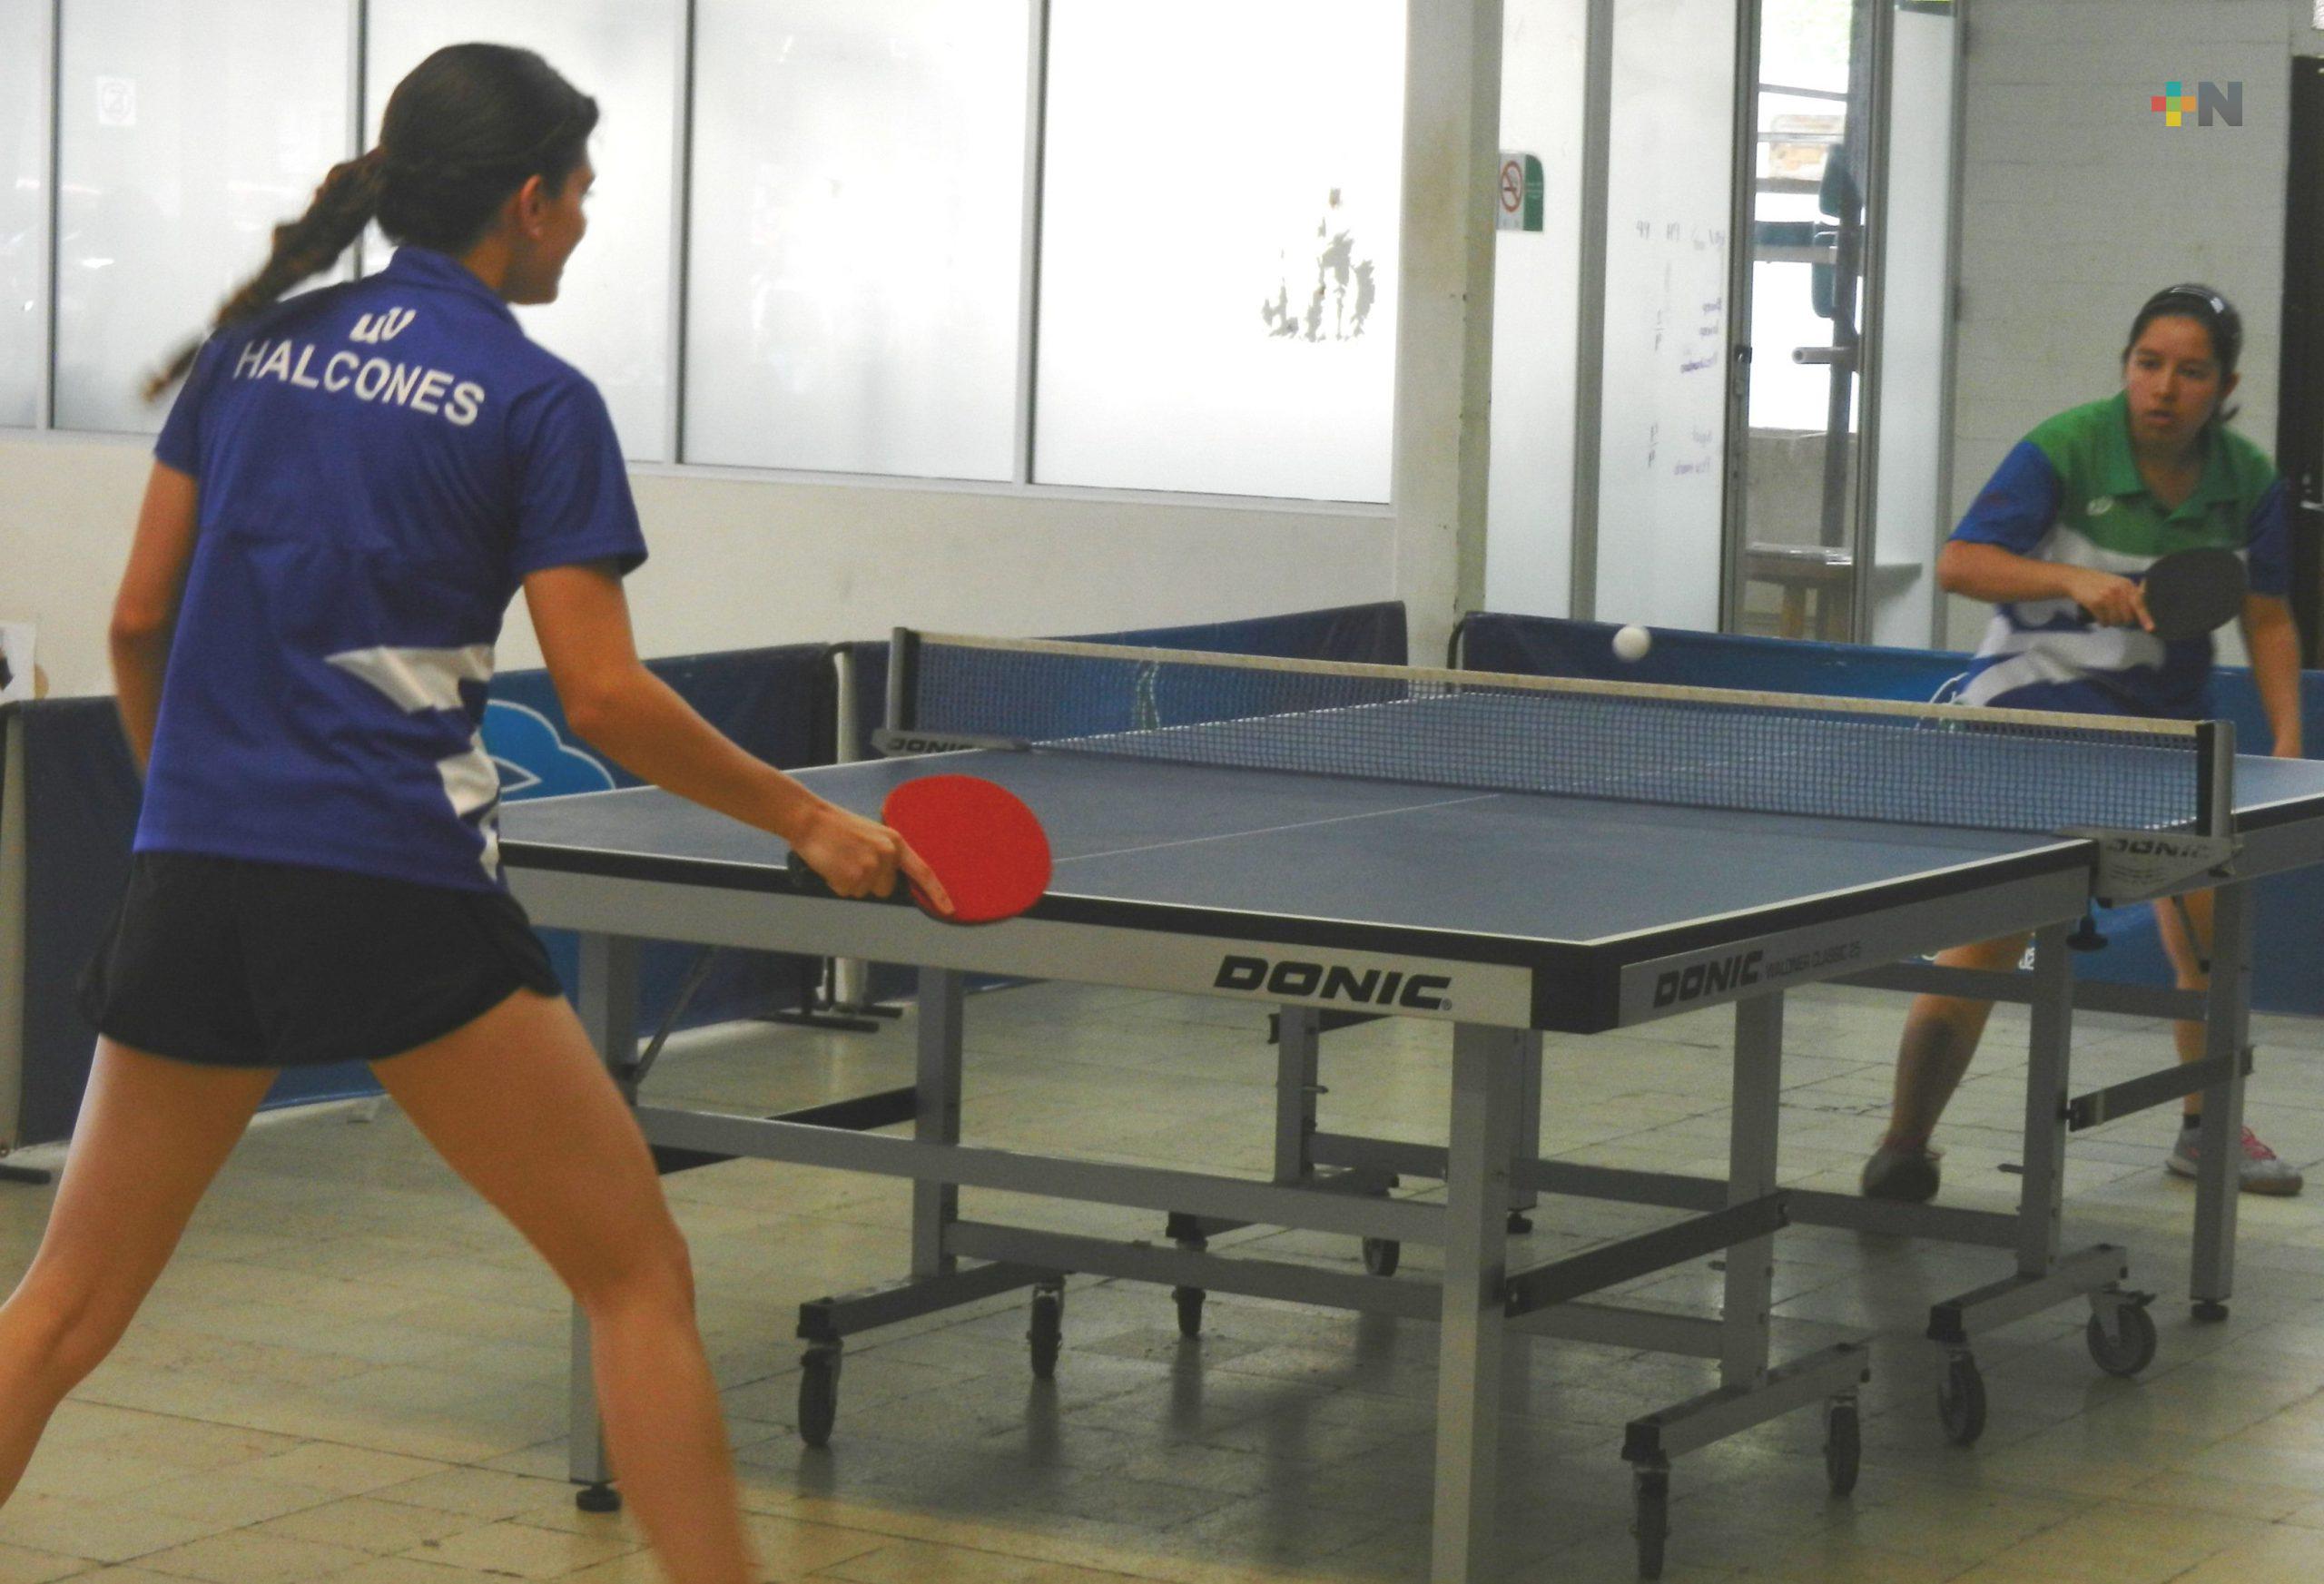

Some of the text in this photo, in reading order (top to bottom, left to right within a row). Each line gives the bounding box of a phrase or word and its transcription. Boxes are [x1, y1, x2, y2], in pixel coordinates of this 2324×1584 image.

[232, 339, 485, 426] HALCONES
[1214, 955, 1452, 1010] DONIC
[1653, 949, 1764, 1008] DONIC
